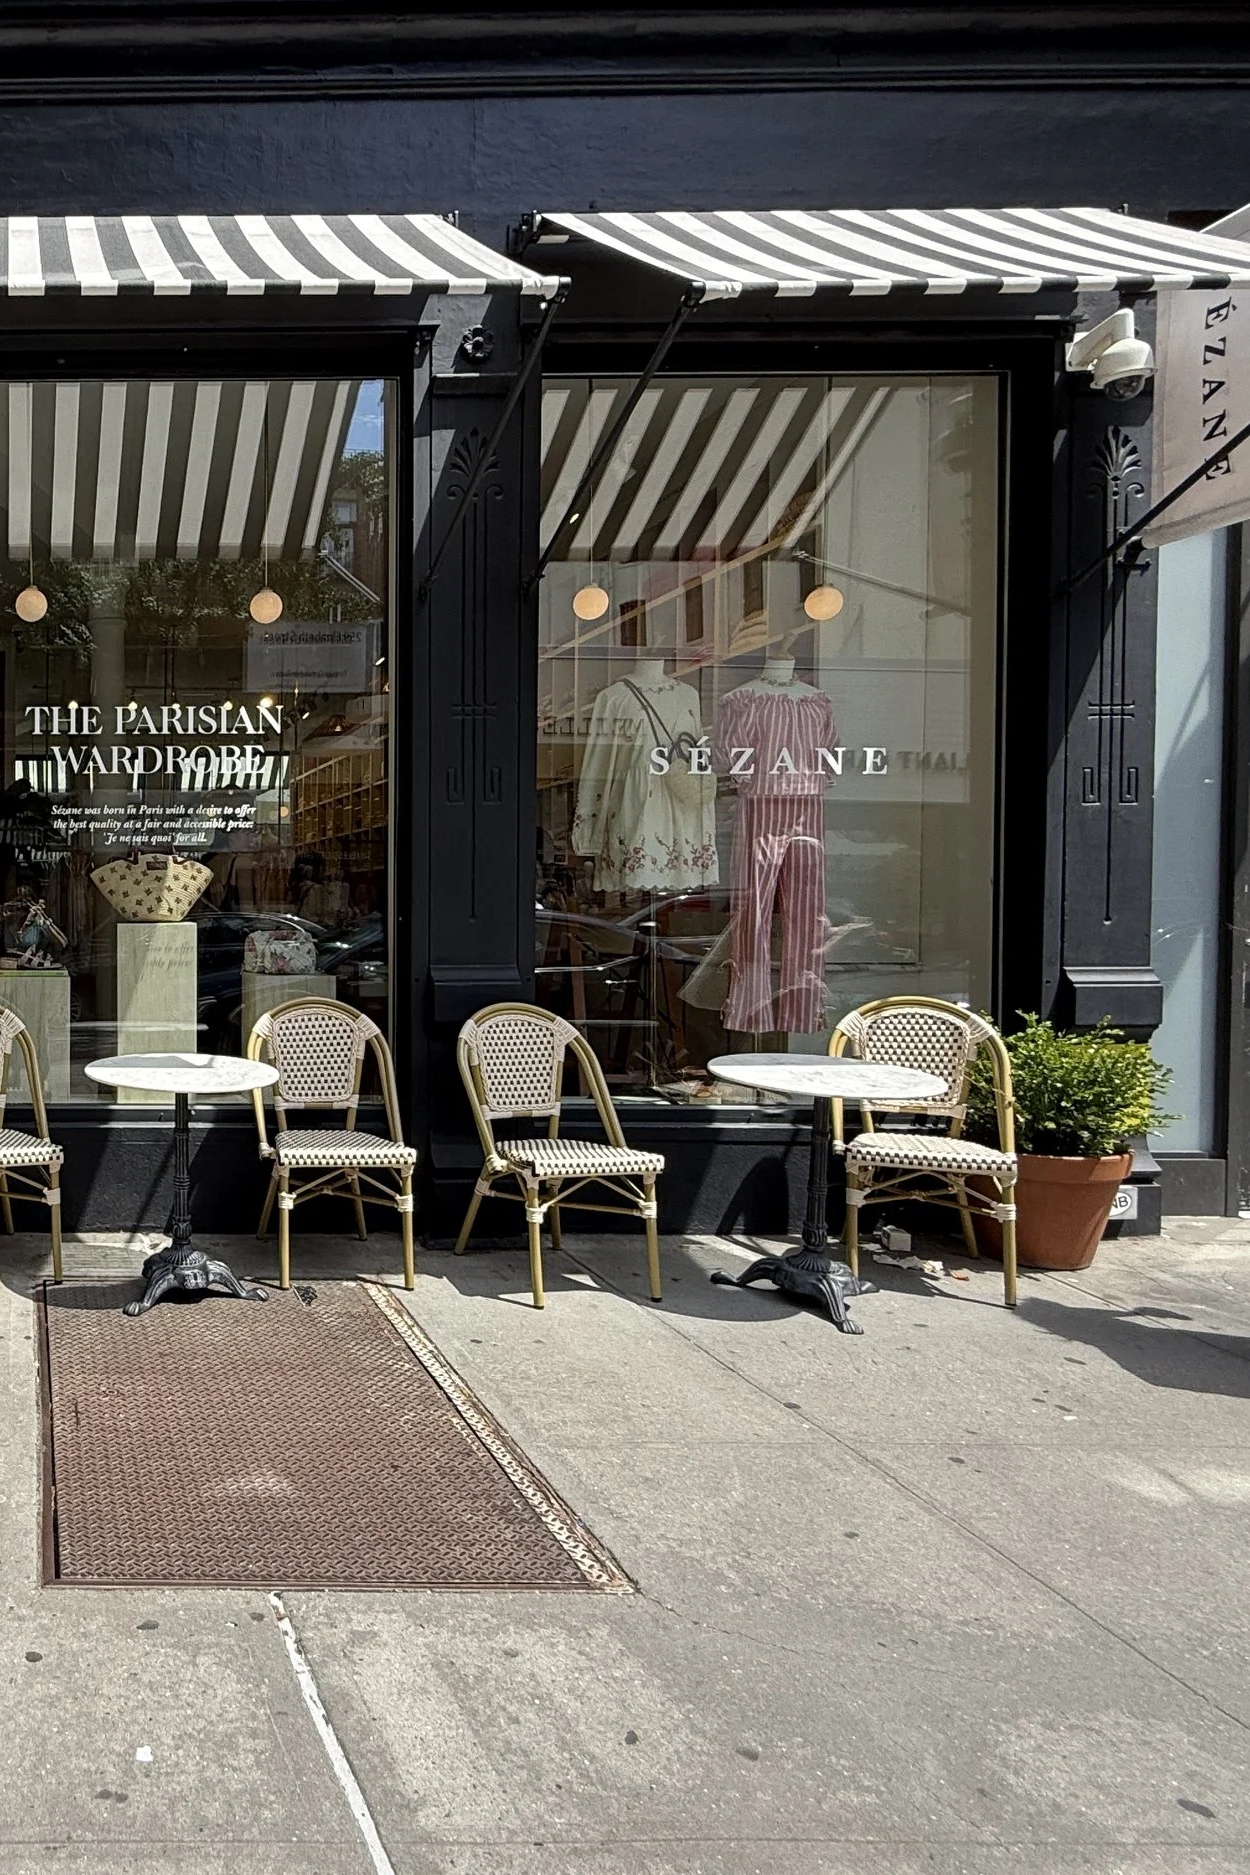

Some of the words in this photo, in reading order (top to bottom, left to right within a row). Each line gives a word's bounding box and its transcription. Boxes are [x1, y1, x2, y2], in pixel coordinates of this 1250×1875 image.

[1202, 295, 1238, 482] ÉZANE
[25, 706, 103, 735] THE
[114, 705, 283, 735] PARISIAN
[51, 745, 266, 774] WARDROBE
[649, 735, 888, 775] SÉZANE
[51, 805, 82, 816] Sézane
[84, 807, 101, 815] was
[103, 804, 125, 815] born
[126, 804, 137, 815] in
[139, 804, 163, 815] Paris
[165, 804, 186, 815] with
[187, 806, 195, 815] a
[196, 804, 222, 815] desire
[223, 806, 234, 815] to
[234, 803, 257, 818] offer
[53, 818, 68, 829] the
[70, 818, 88, 829] best
[88, 818, 122, 832] quality
[123, 820, 135, 829] at
[135, 821, 143, 829] a
[141, 818, 163, 832] fair
[163, 818, 182, 829] and
[183, 818, 227, 829] accessible
[119, 835, 130, 843] ne
[131, 832, 149, 843] sais
[175, 831, 190, 845] for
